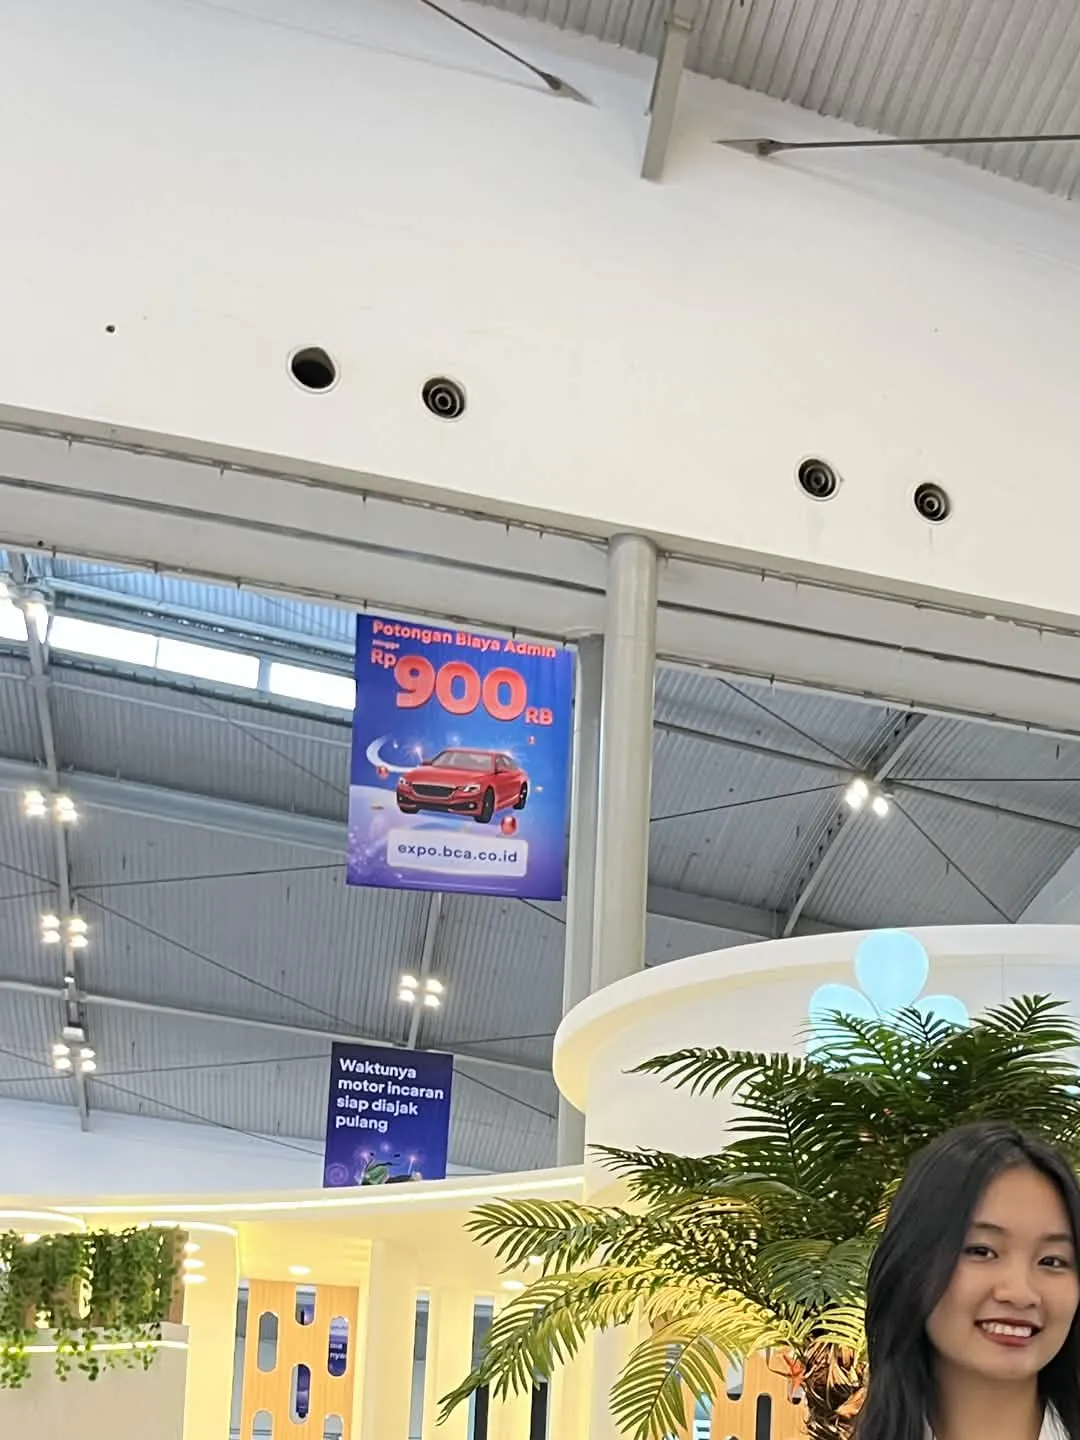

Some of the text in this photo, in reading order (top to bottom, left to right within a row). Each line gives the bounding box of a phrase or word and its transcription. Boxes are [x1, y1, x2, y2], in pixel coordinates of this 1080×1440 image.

[372, 620, 557, 658] Potongan Biaya Admin
[371, 648, 553, 725] Rp 900 RB
[398, 843, 518, 863] expo.bca.co.id
[339, 1058, 416, 1079] Waktunya
[338, 1079, 444, 1100] motor incaran
[336, 1095, 419, 1117] siap diajak
[335, 1115, 388, 1133] pulang
